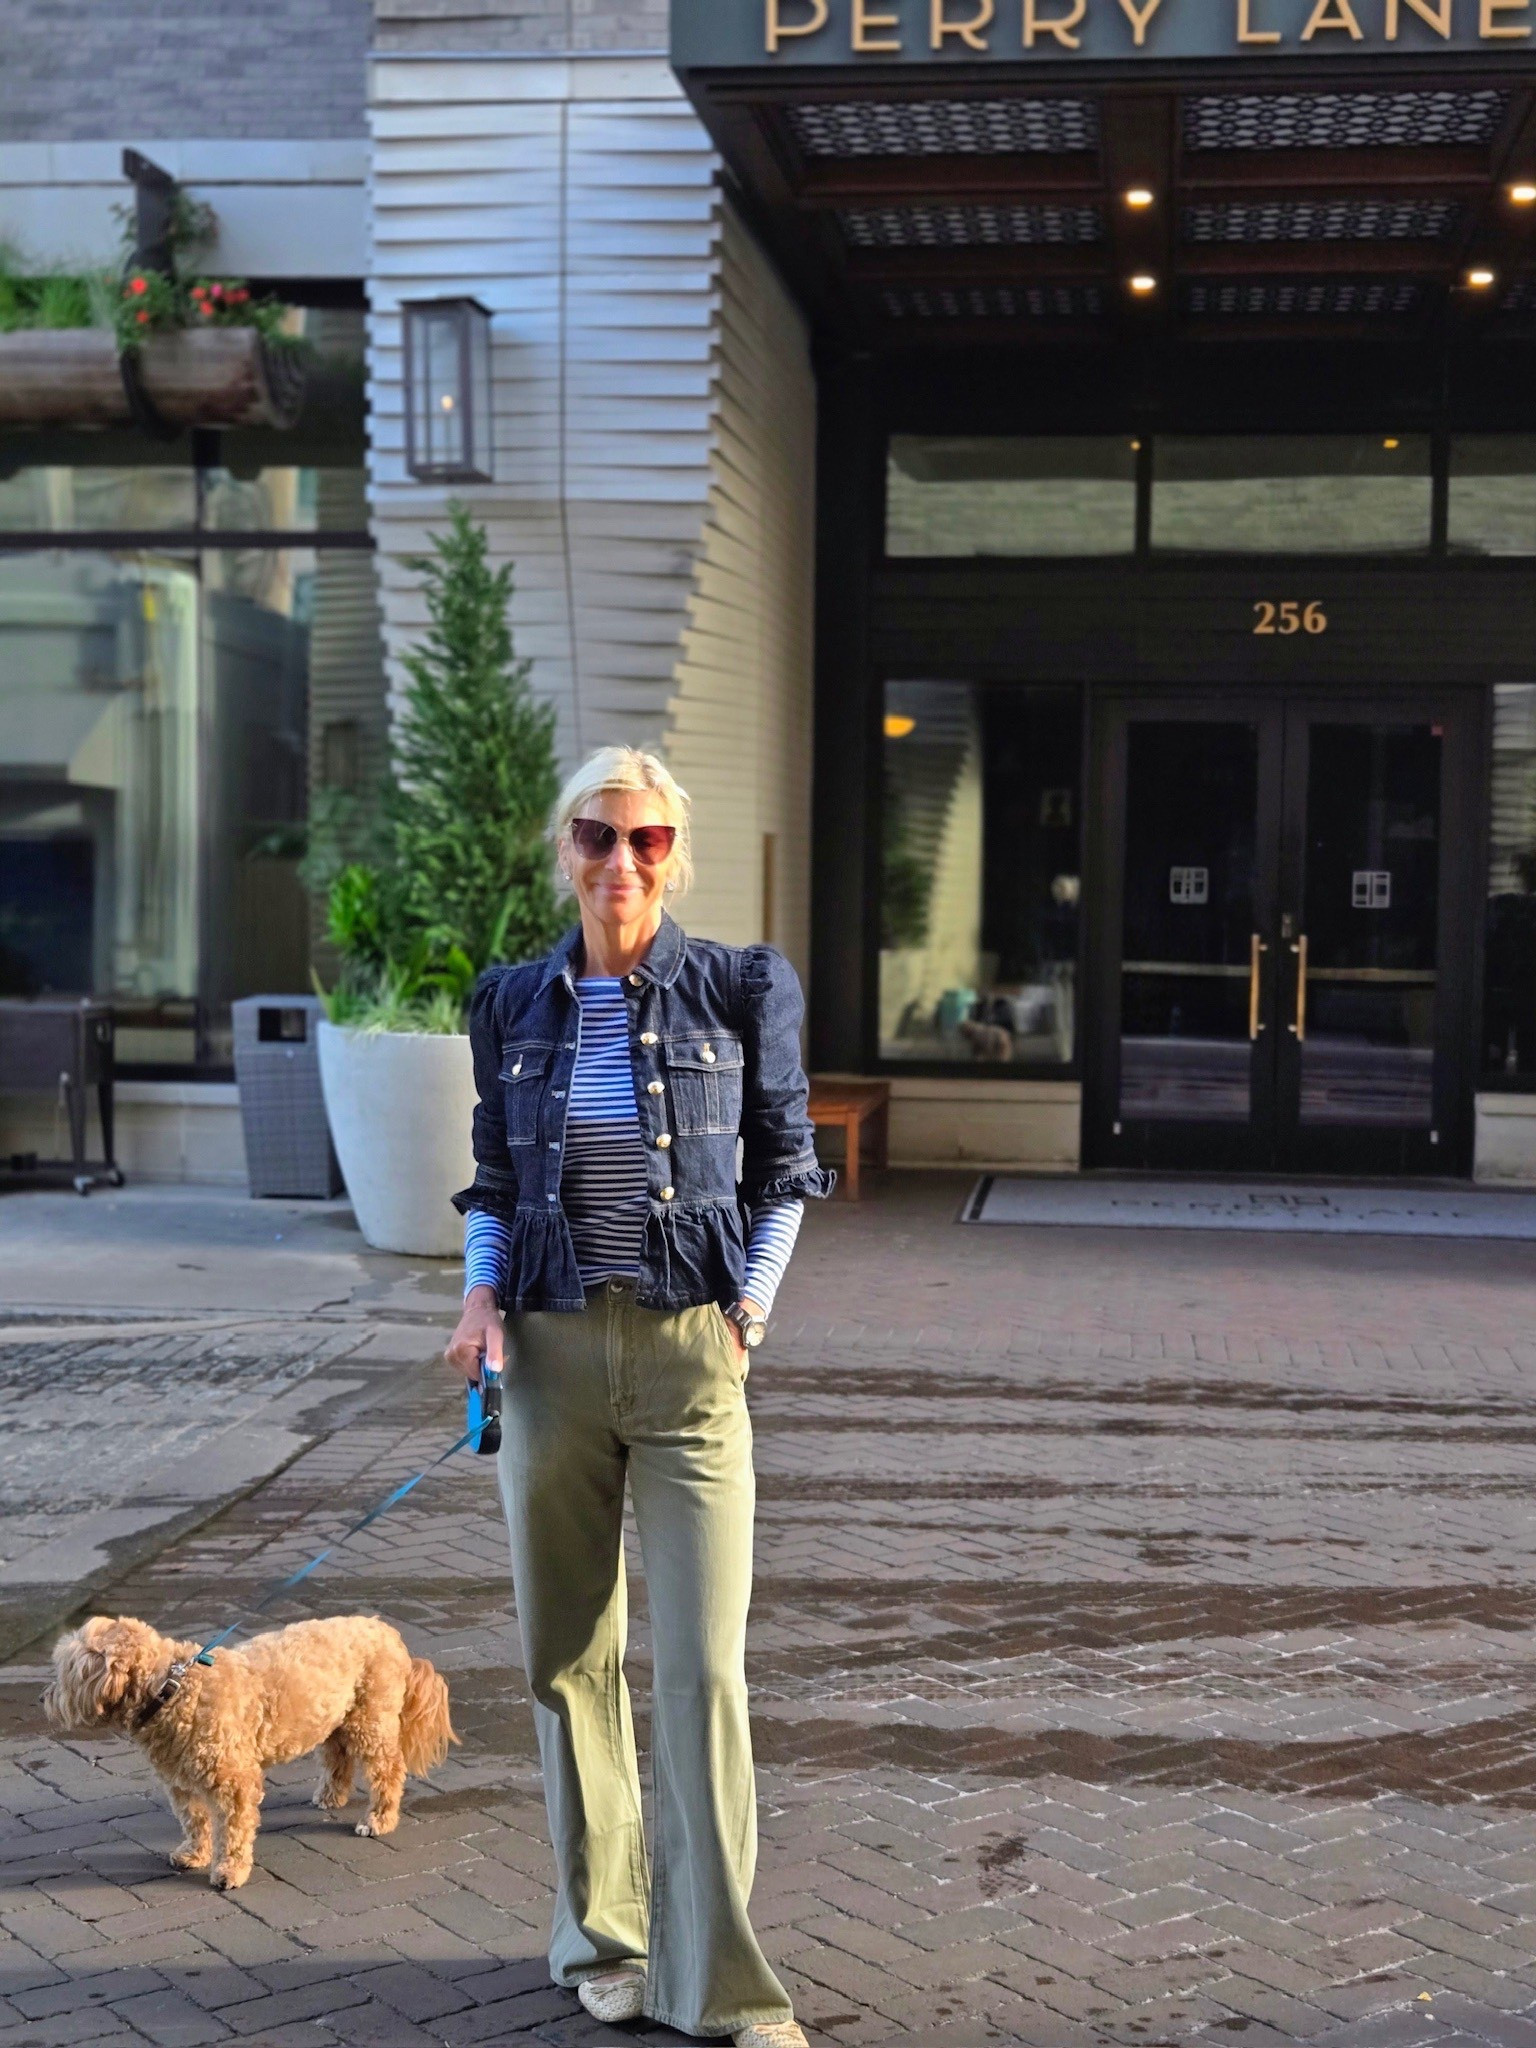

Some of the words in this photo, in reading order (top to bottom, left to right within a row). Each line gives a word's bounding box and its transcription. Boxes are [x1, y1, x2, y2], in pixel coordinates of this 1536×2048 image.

[764, 0, 1162, 53] PERRY
[1236, 0, 1533, 43] LANE
[1252, 601, 1328, 634] 256
